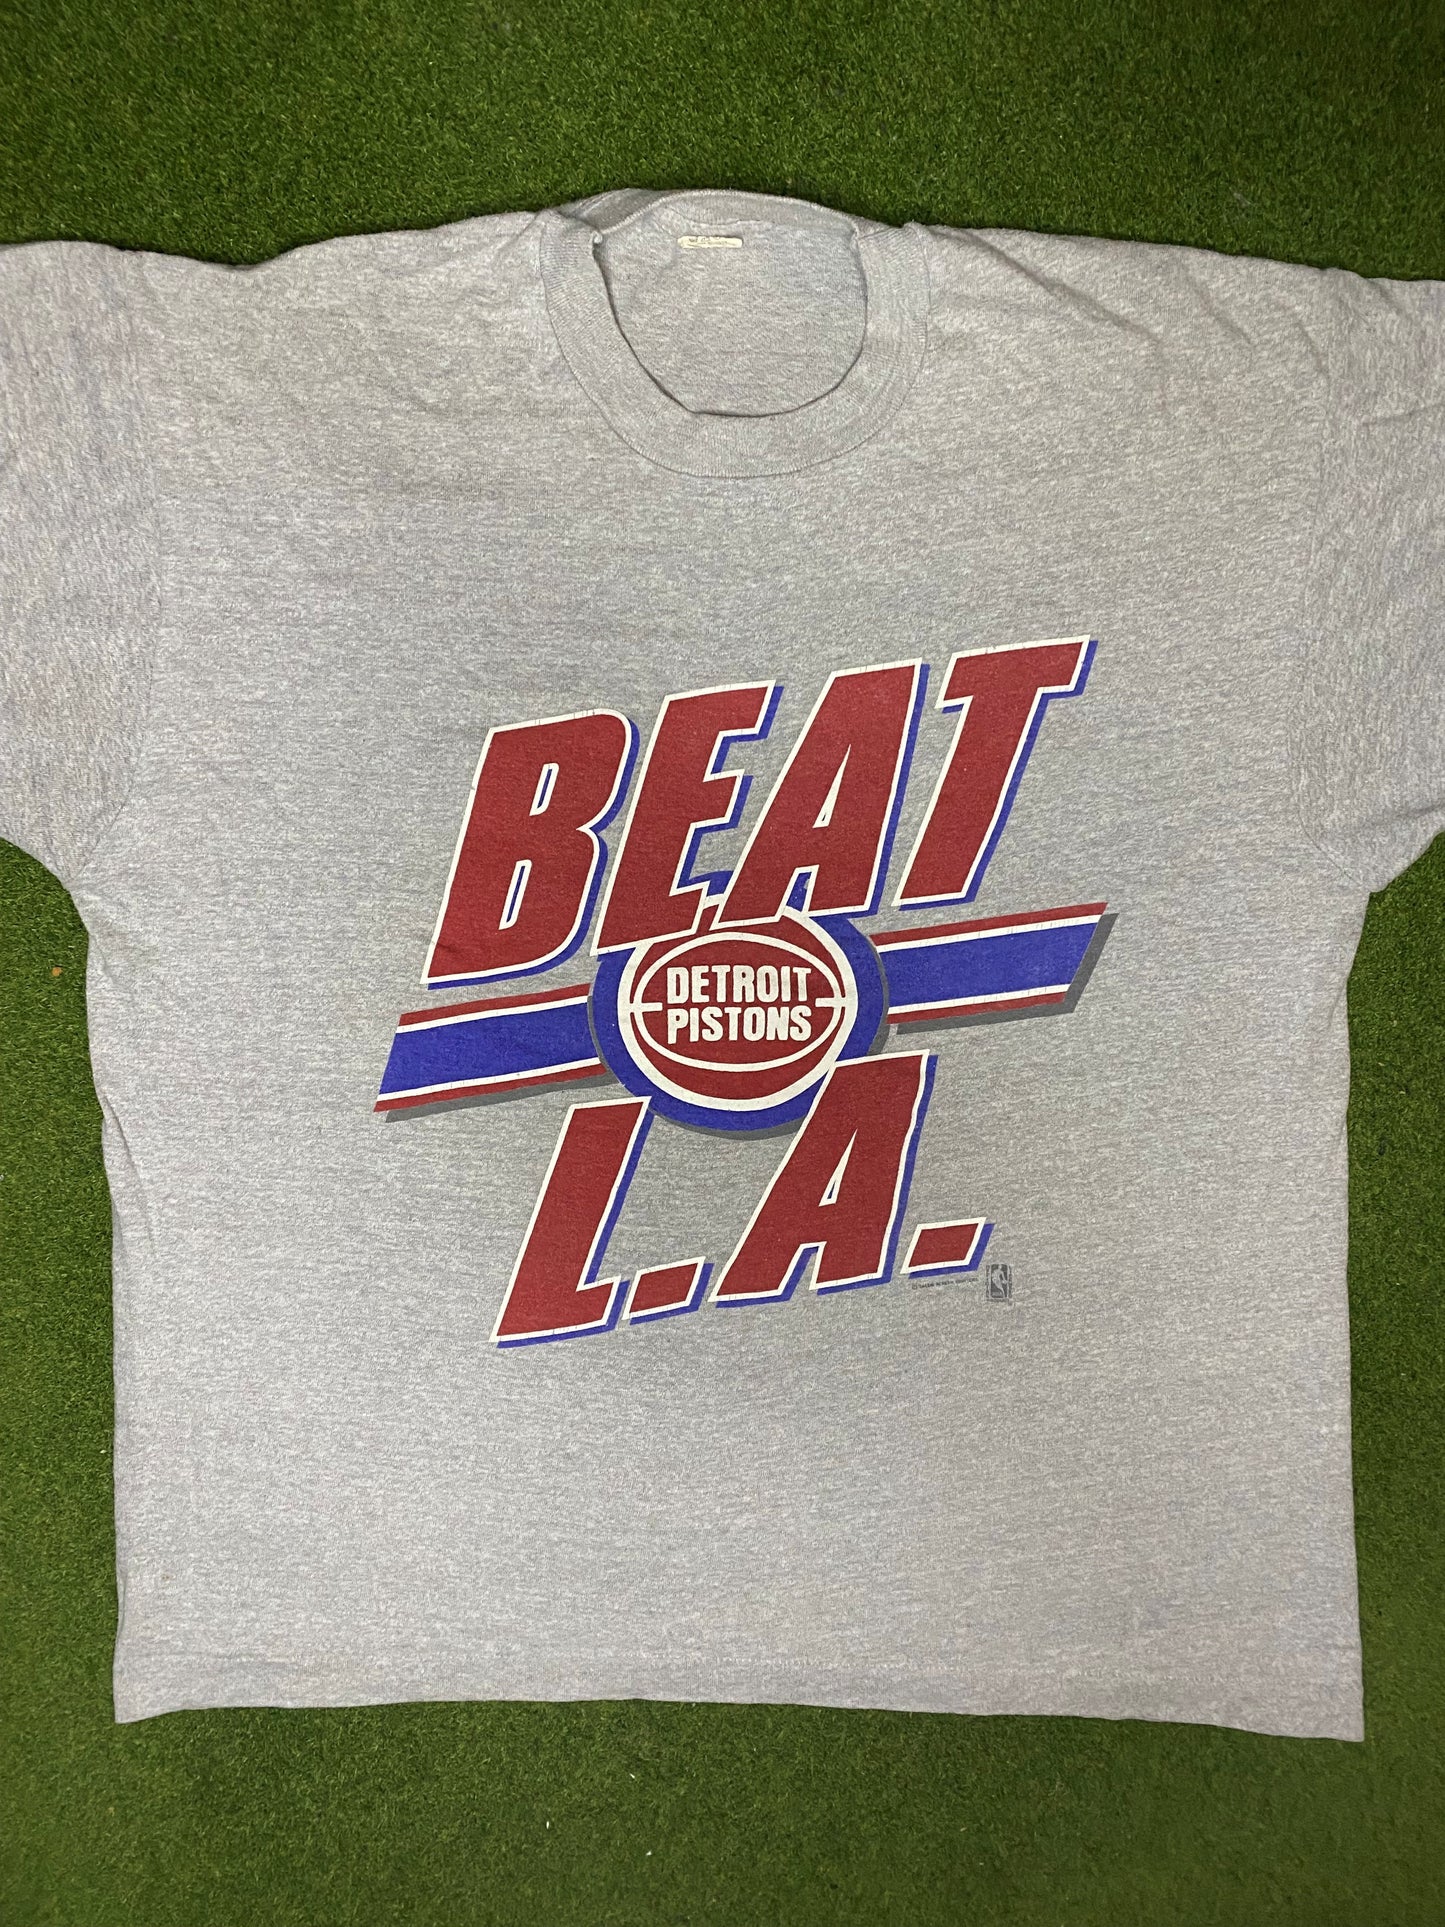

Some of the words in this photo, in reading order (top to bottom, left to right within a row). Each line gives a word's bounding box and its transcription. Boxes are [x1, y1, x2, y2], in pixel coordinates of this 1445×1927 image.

[421, 635, 1097, 988] BEAT
[667, 965, 811, 1004] DETROIT
[667, 1005, 812, 1044] PISTONS
[490, 1050, 993, 1347] L.A.
